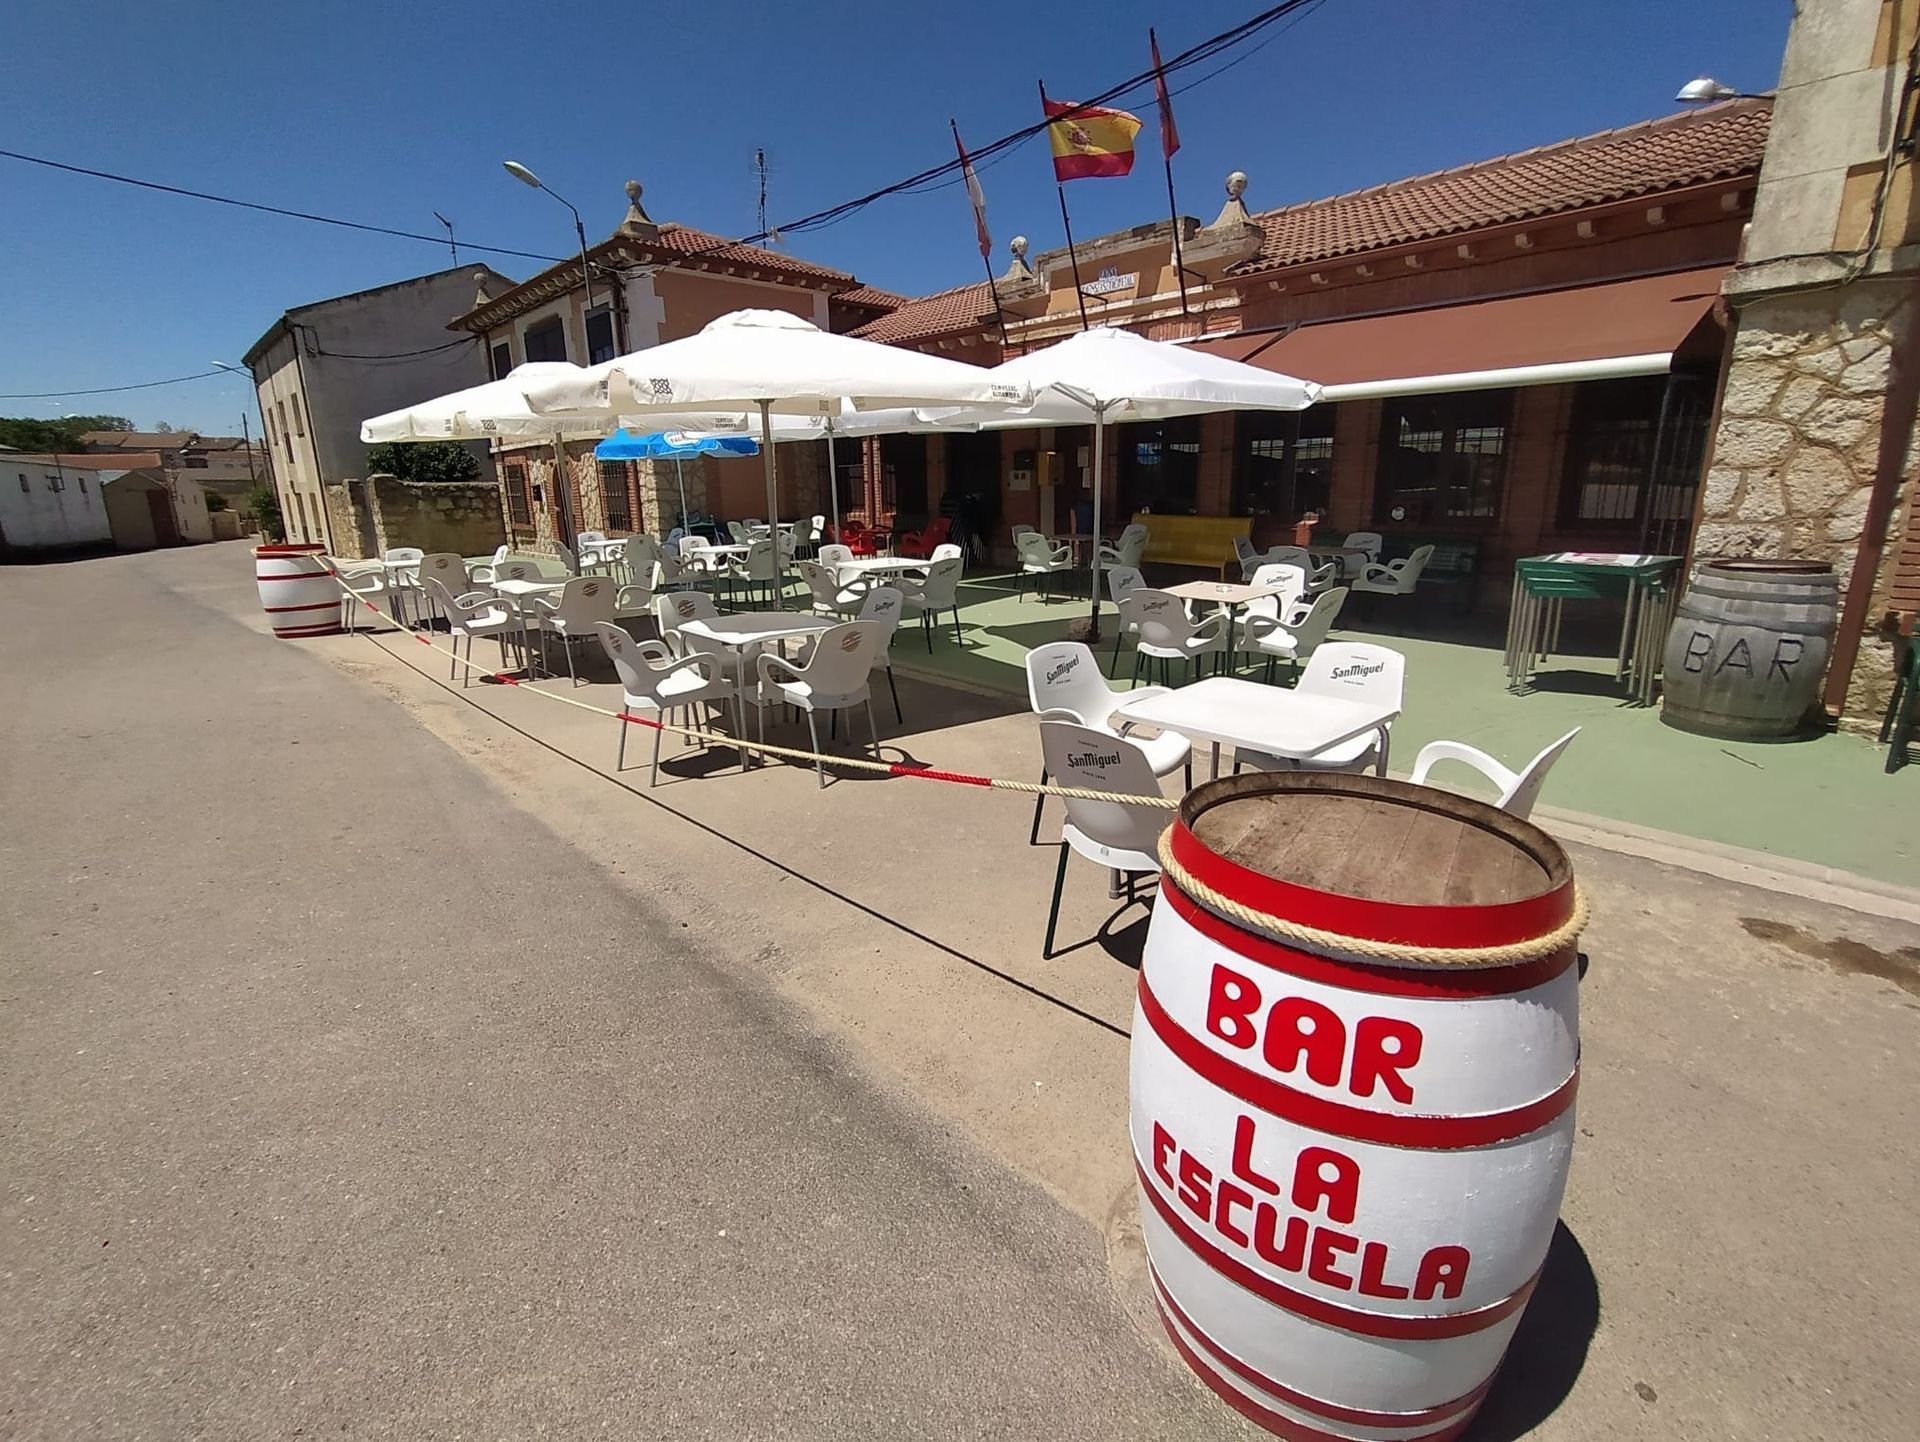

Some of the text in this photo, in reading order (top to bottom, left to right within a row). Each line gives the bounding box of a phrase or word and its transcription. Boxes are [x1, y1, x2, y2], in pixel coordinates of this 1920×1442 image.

[1046, 654, 1080, 685] SanMiguel
[1329, 661, 1384, 680] SanMiguel
[1683, 631, 1806, 682] BAR
[1067, 751, 1121, 769] SanMiguel
[1206, 963, 1423, 1105] BAR
[1231, 1115, 1361, 1225] LA
[1153, 1120, 1471, 1301] ESCUELA
